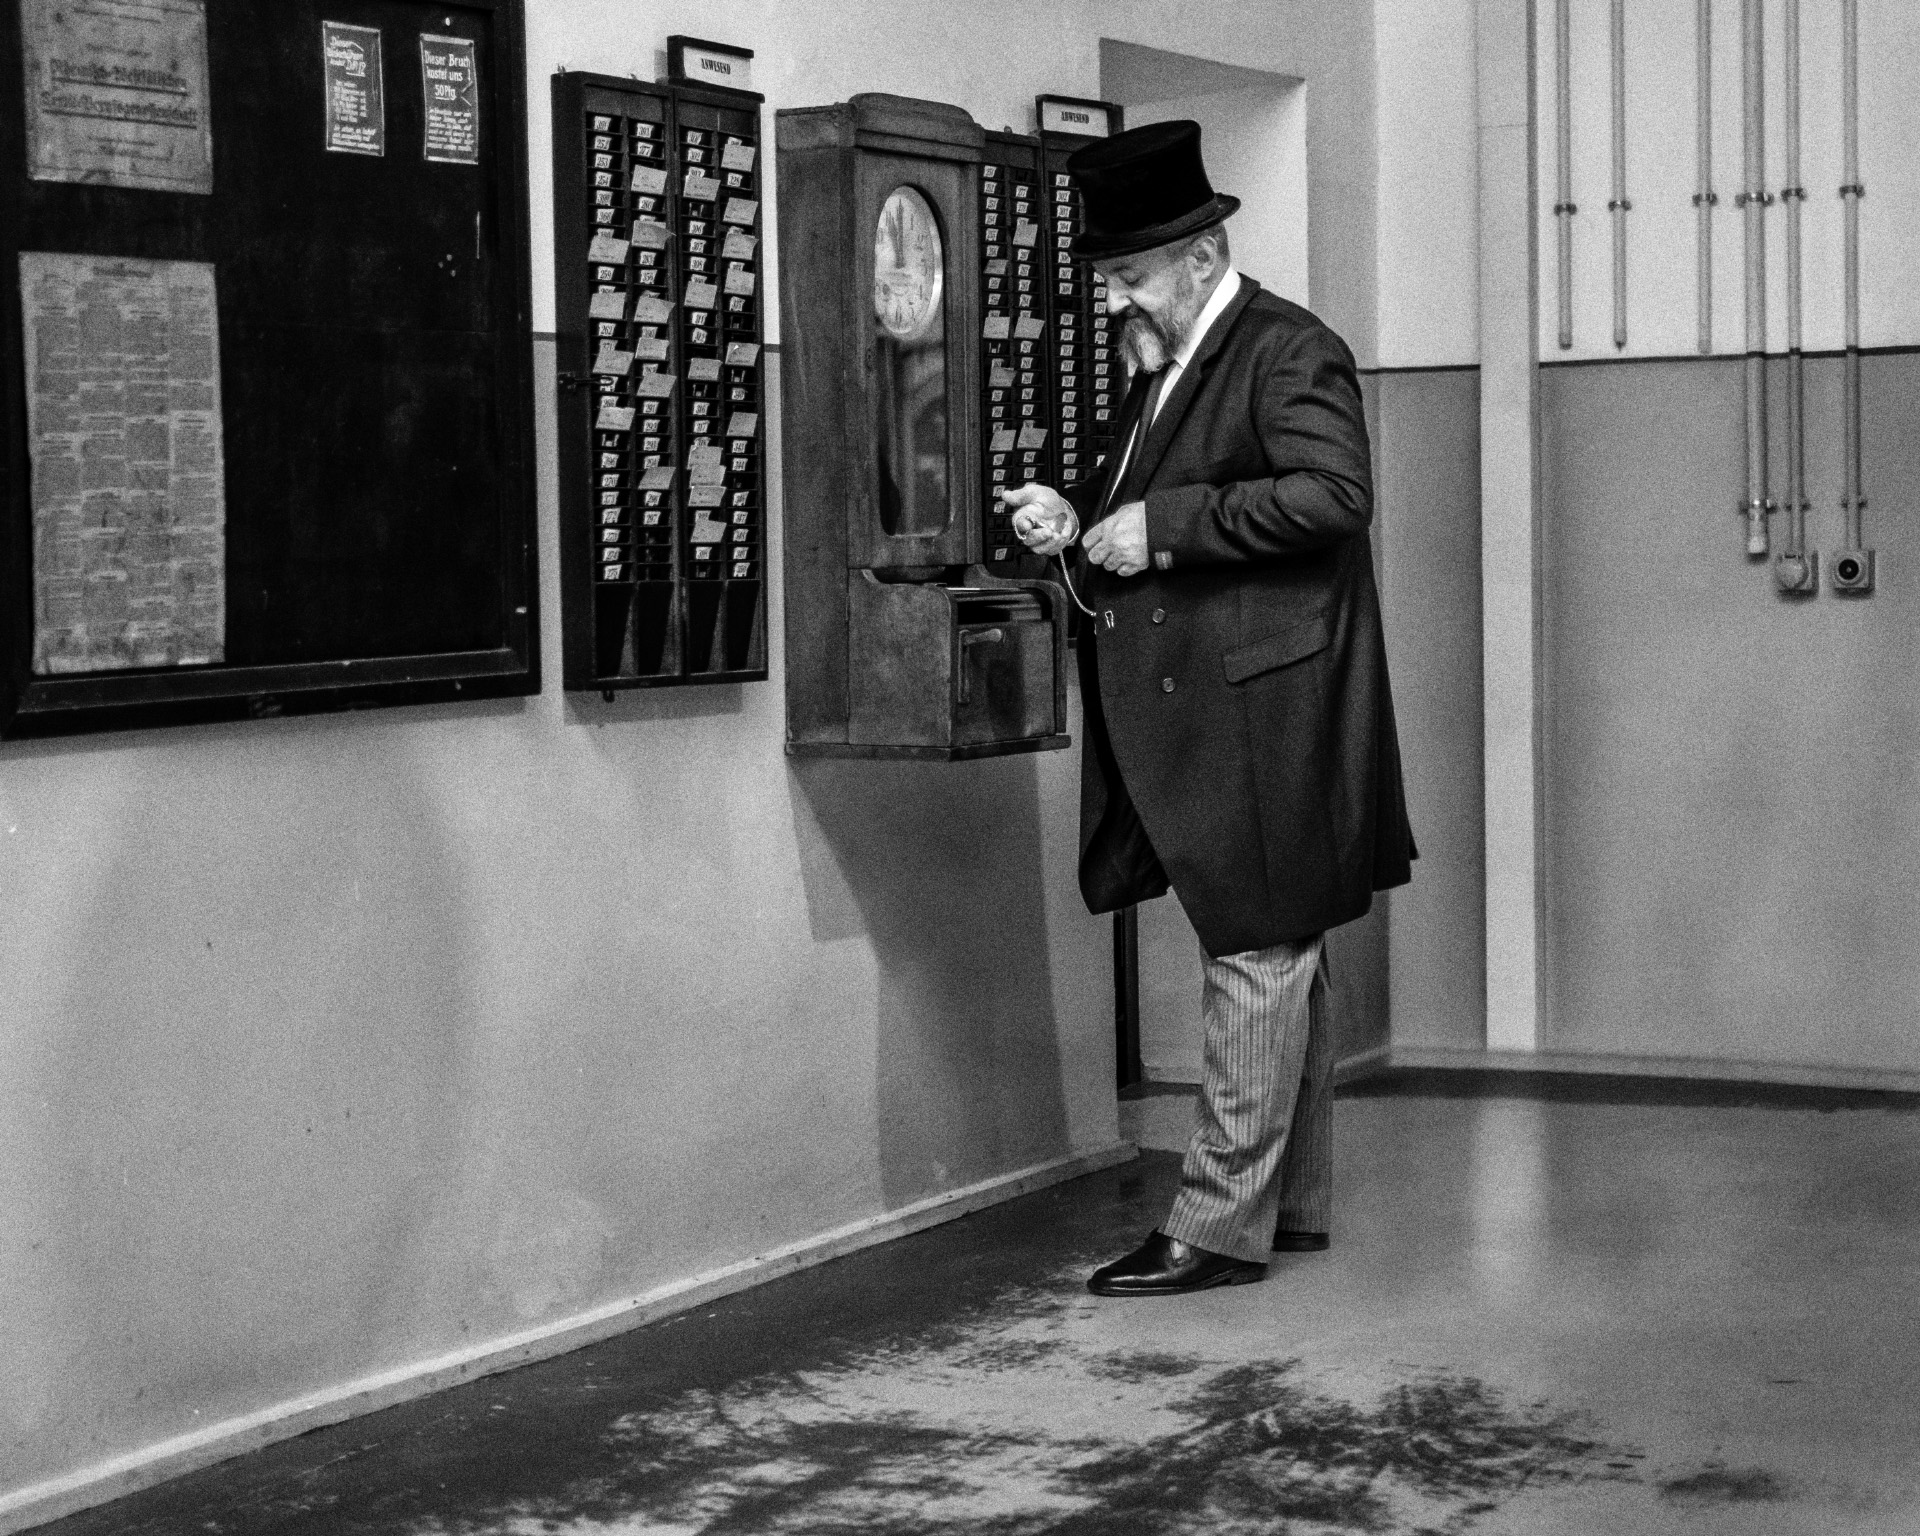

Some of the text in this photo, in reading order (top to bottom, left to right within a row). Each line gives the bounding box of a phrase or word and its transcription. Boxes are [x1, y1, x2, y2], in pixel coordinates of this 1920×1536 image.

[424, 50, 471, 68] Dieser Bruch
[426, 66, 464, 82] kostet uns
